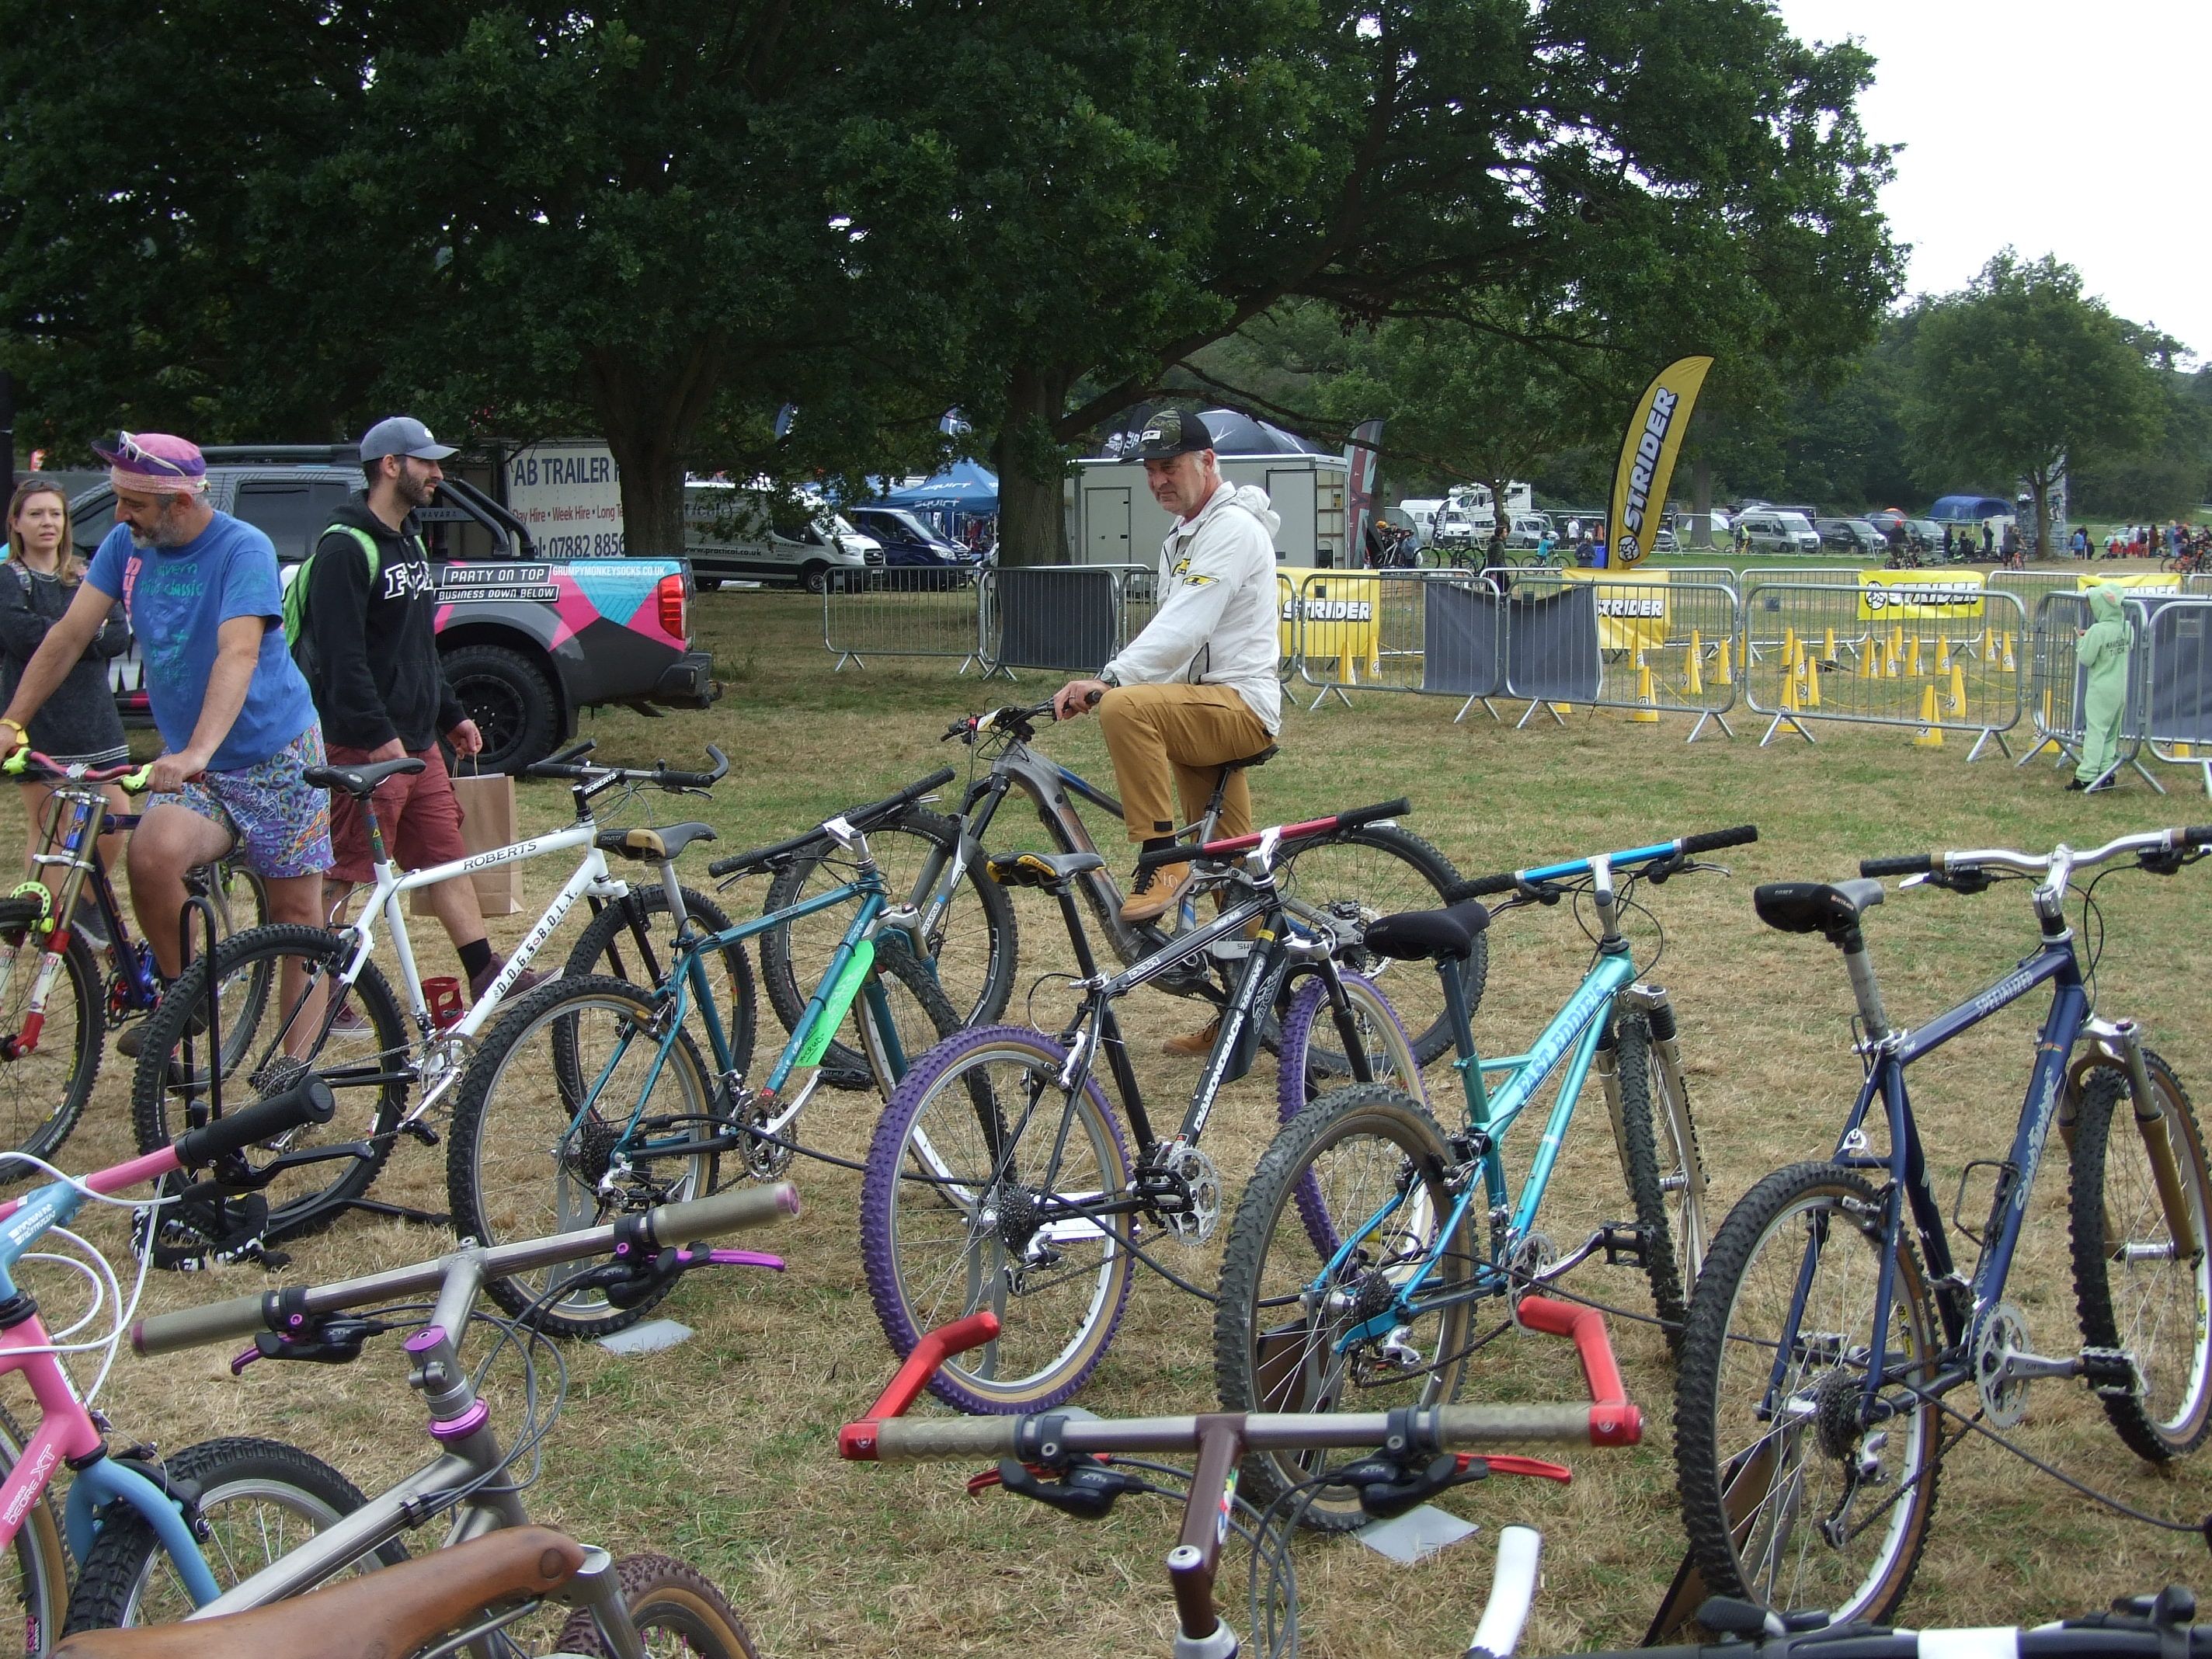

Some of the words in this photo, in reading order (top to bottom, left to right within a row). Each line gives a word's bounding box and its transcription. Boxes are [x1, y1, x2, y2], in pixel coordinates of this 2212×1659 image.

[513, 458, 537, 486] AB
[542, 457, 610, 485] TRAILER
[1623, 387, 1678, 537] STRIDER
[530, 507, 545, 523] Hire
[552, 506, 572, 521] Week
[575, 505, 590, 520] Hire
[597, 505, 615, 521] Long
[533, 537, 546, 558] el:
[549, 535, 591, 558] 07882
[450, 569, 492, 583] PARTY
[496, 569, 514, 582] ON
[520, 568, 544, 580] TOP
[552, 565, 666, 576] GRUMPYMONKEYSOCKS.CO.UK
[438, 590, 485, 600] BUSINESS
[489, 589, 516, 599] DOWN
[520, 588, 555, 598] BELOW
[1282, 600, 1372, 621] STRIDER
[585, 772, 617, 795] ROBERTS
[463, 840, 537, 871] ROBERTS
[1310, 910, 1340, 928] FORCE
[1975, 971, 2034, 1017] SPECIALIZED
[1194, 1010, 1245, 1132] DIAMONDBACK
[8, 1479, 40, 1525] DEORE
[30, 1443, 55, 1482] XT
[2, 1485, 27, 1520] SHIMANO
